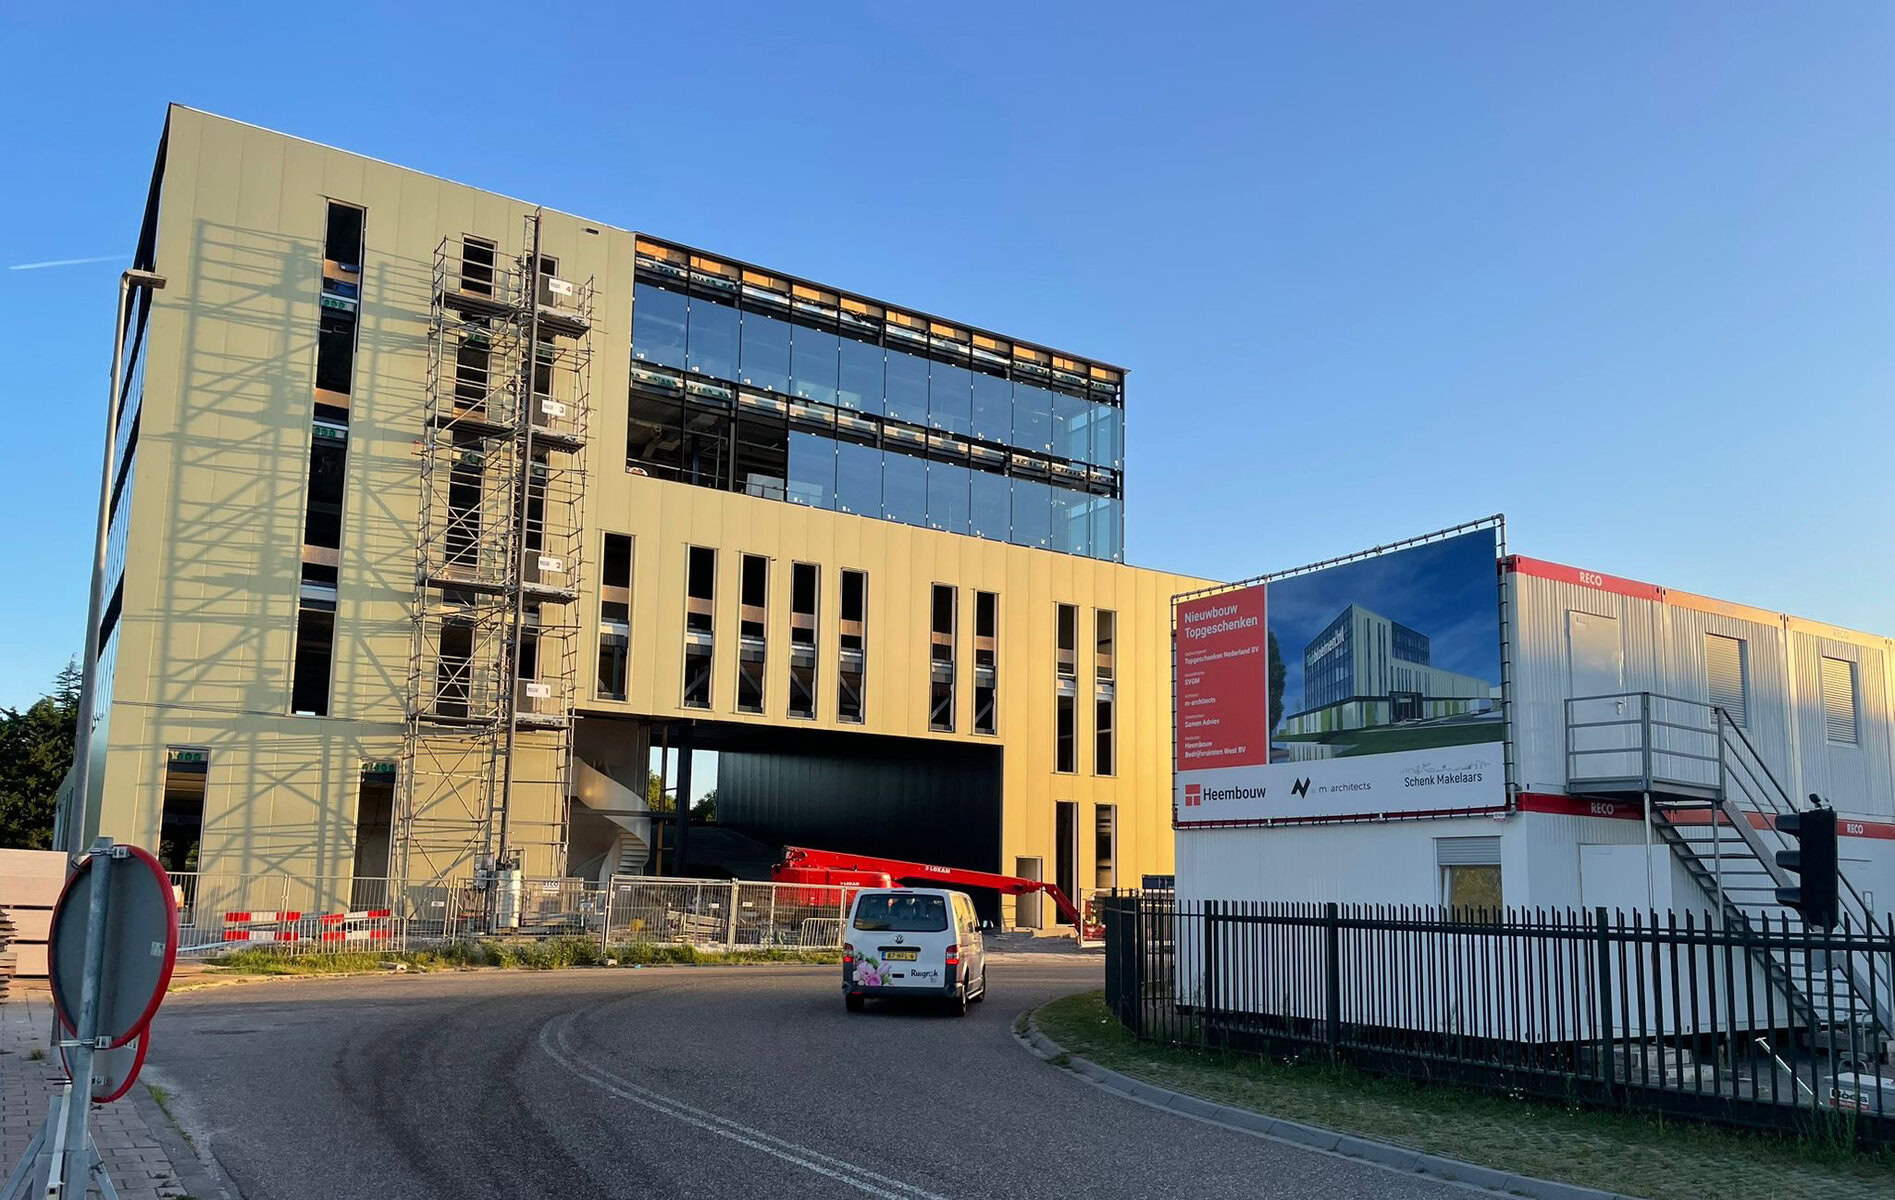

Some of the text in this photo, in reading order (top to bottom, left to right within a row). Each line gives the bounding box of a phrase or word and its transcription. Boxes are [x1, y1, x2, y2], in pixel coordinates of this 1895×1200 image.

[1579, 571, 1603, 587] RECO
[1184, 605, 1238, 624] Nieuwbouw
[1184, 616, 1258, 639] Topgeschenken
[1223, 648, 1251, 658] Nederland
[1224, 747, 1238, 755] West
[1238, 746, 1247, 754] BV
[1404, 772, 1483, 788] Schenk Makelaars
[1203, 786, 1267, 801] Heembouw
[1330, 782, 1372, 793] architects
[1591, 802, 1614, 815] RECO
[1846, 823, 1864, 835] RECO
[930, 866, 951, 874] LOXAM
